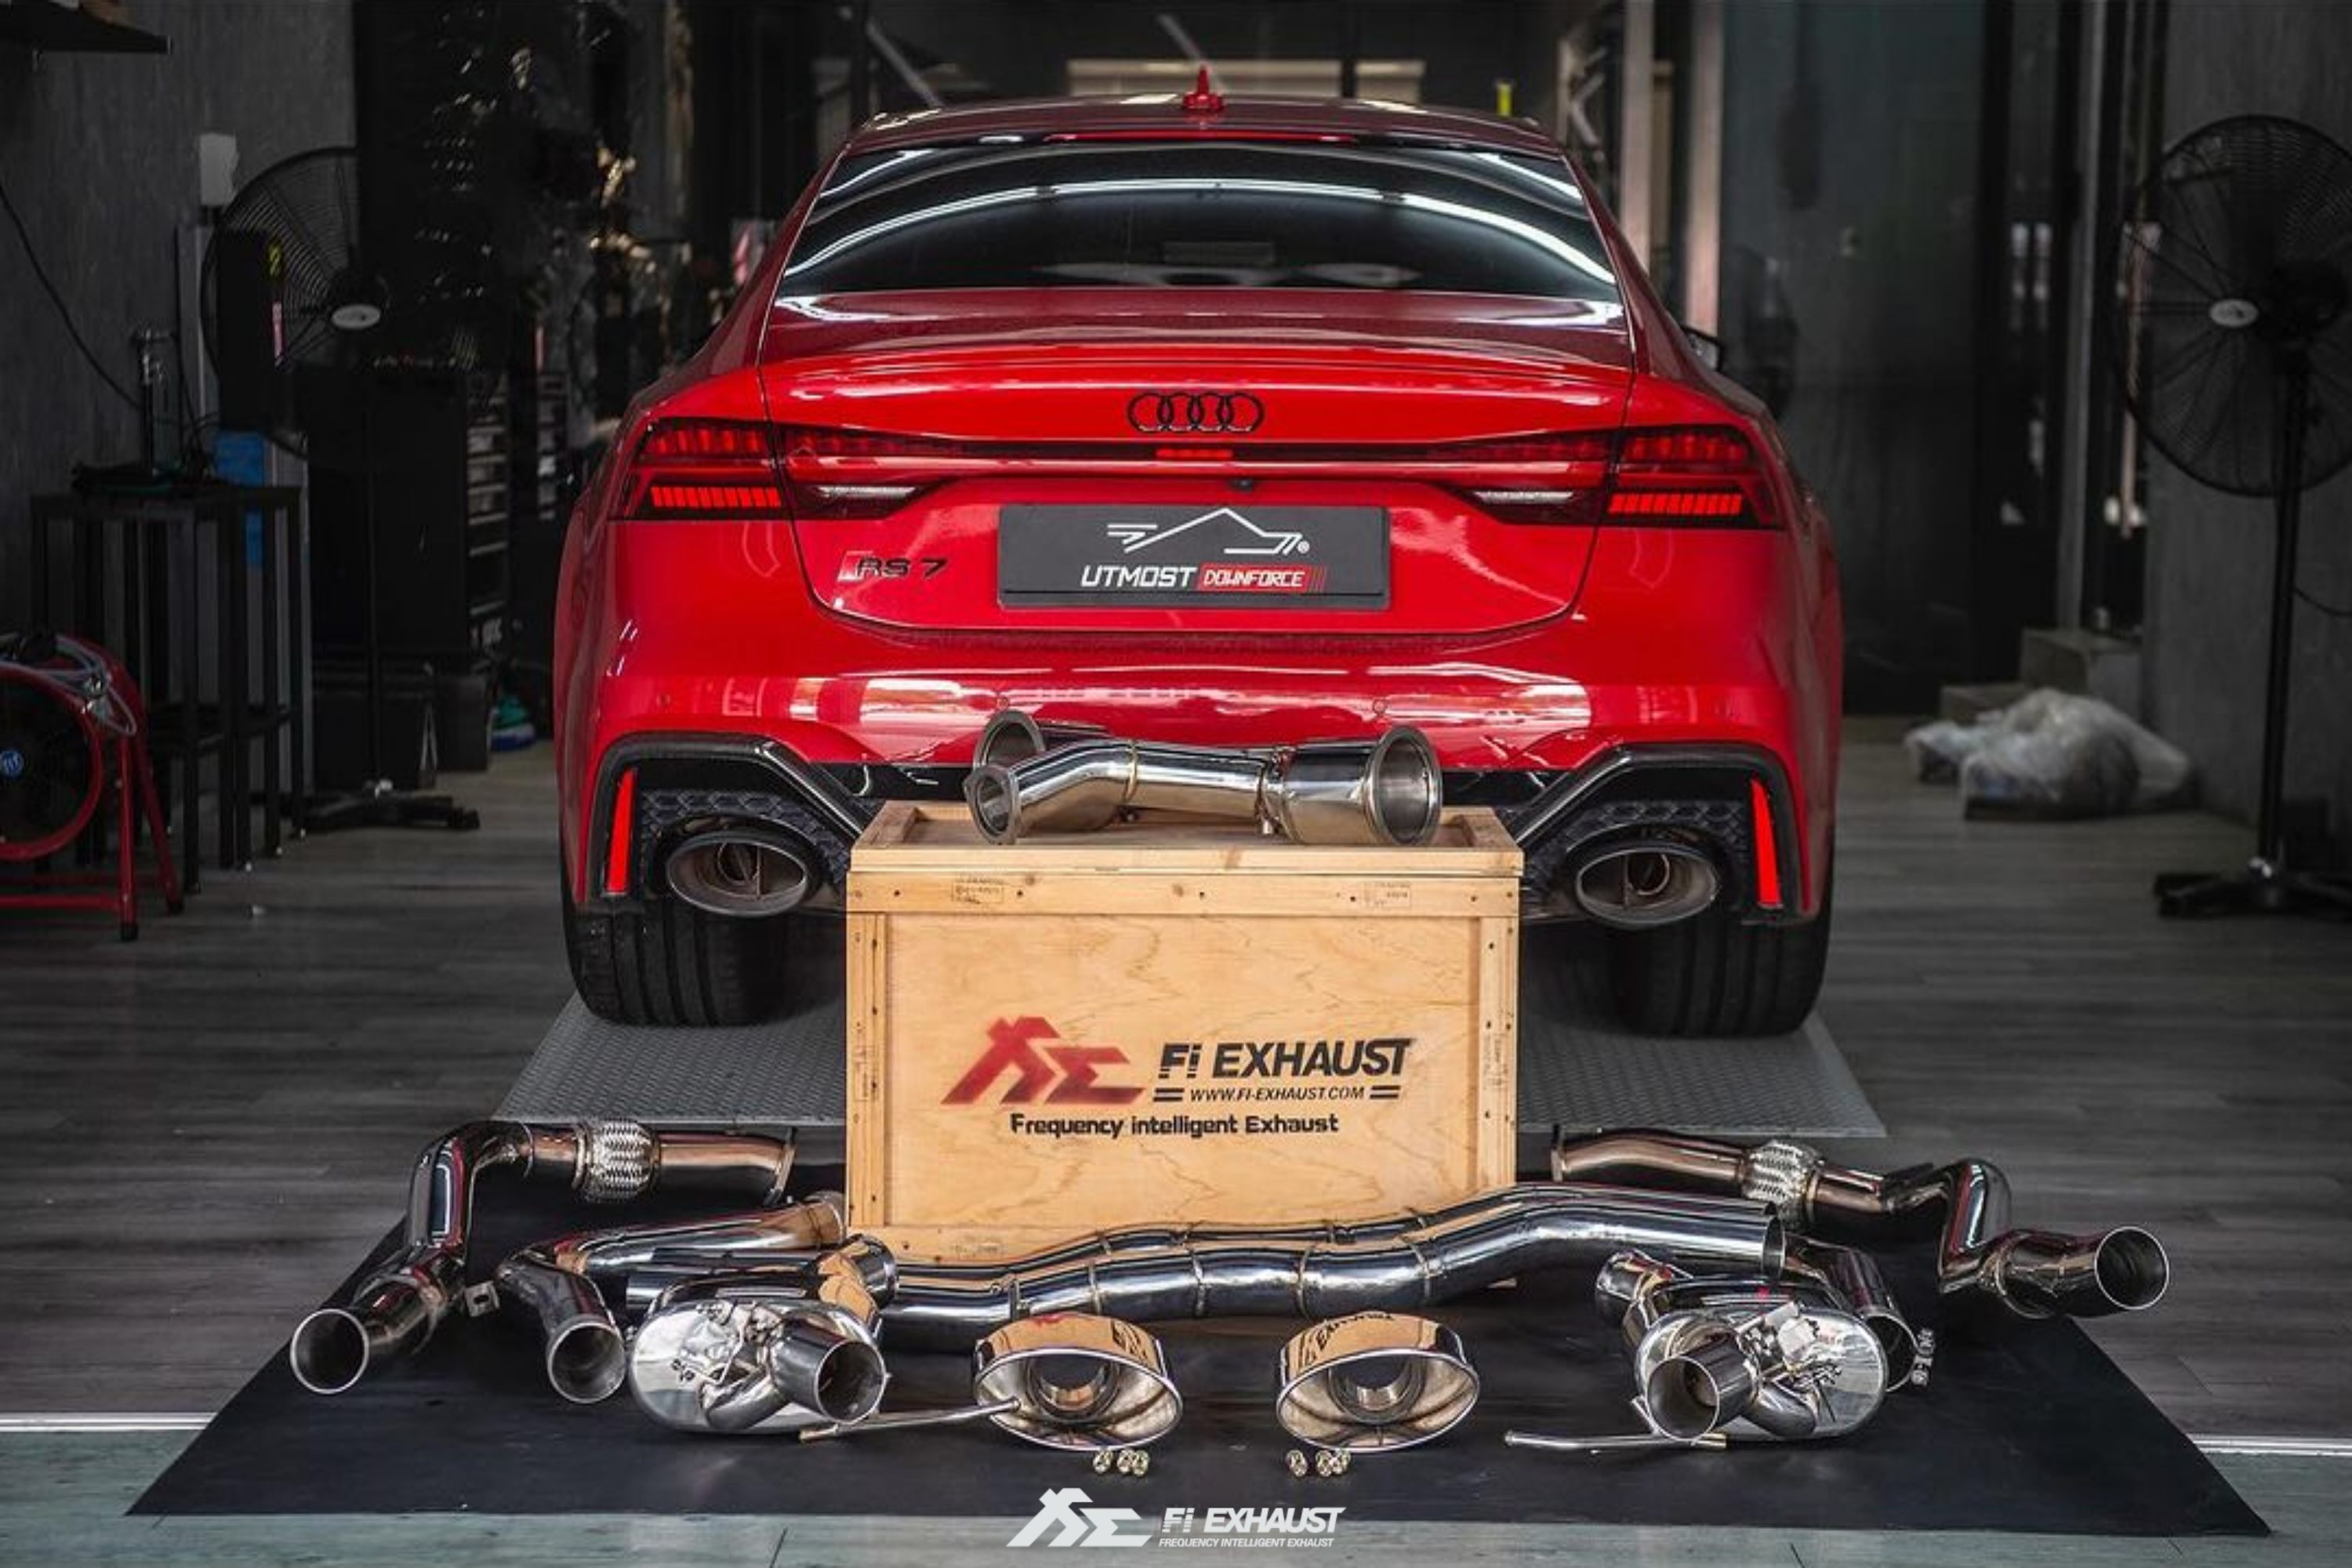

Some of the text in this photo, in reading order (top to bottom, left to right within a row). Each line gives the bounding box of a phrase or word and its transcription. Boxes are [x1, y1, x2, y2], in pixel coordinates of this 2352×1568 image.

[854, 554, 949, 579] RS 7
[1081, 564, 1305, 587] UTMOST DOWNFORCE
[1212, 1037, 1416, 1079] EXHAUST
[1189, 1087, 1365, 1102] WWW.FI-EXHAUST.COM
[1010, 1112, 1339, 1138] Frequency intelligent Exhaust
